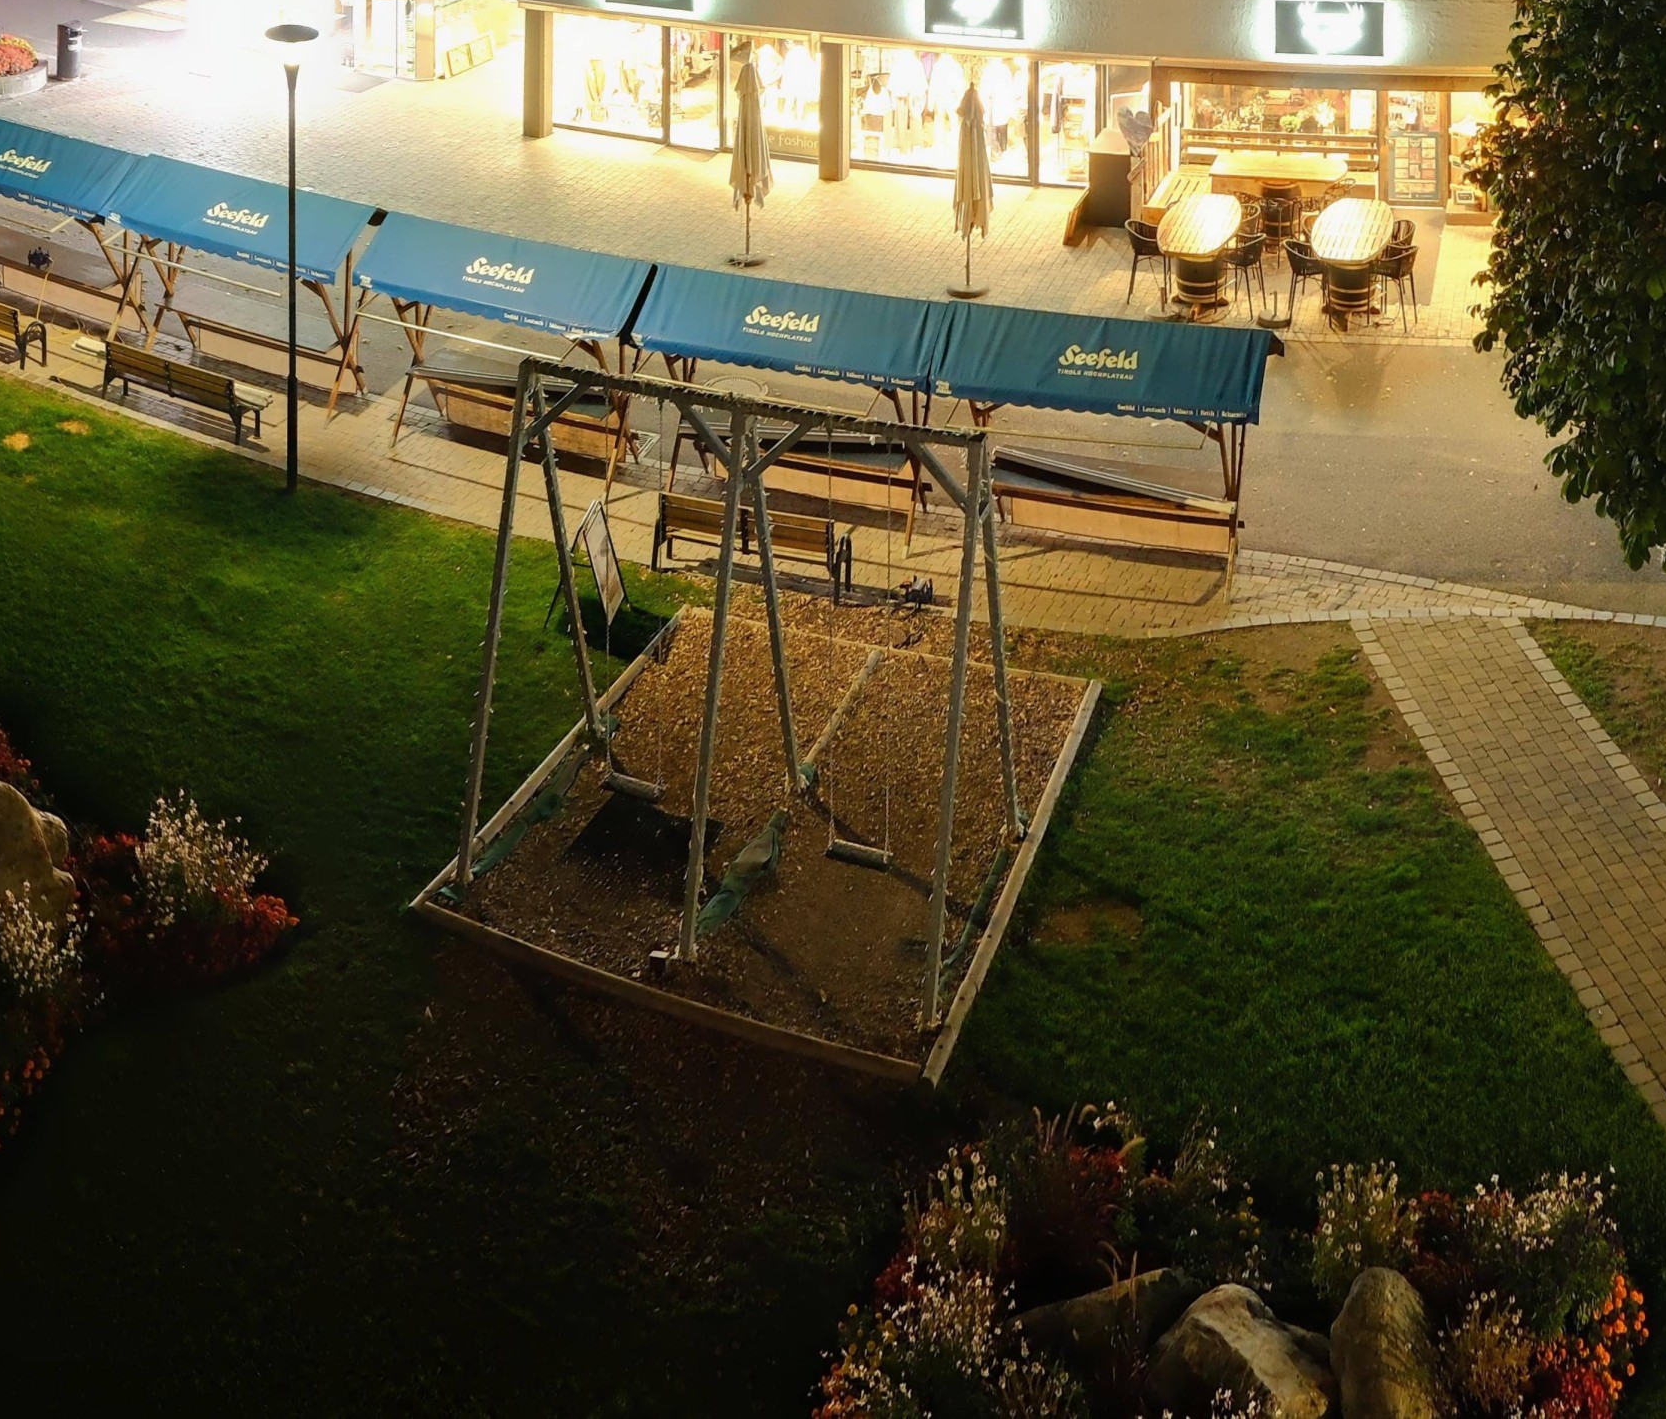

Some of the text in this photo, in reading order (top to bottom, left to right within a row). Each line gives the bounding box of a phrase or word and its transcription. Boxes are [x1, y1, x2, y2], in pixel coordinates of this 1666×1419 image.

[206, 201, 270, 229] Seefeld
[465, 256, 536, 286] Seefeld
[744, 304, 822, 333] Seefeld
[1058, 343, 1140, 371] Seefeld
